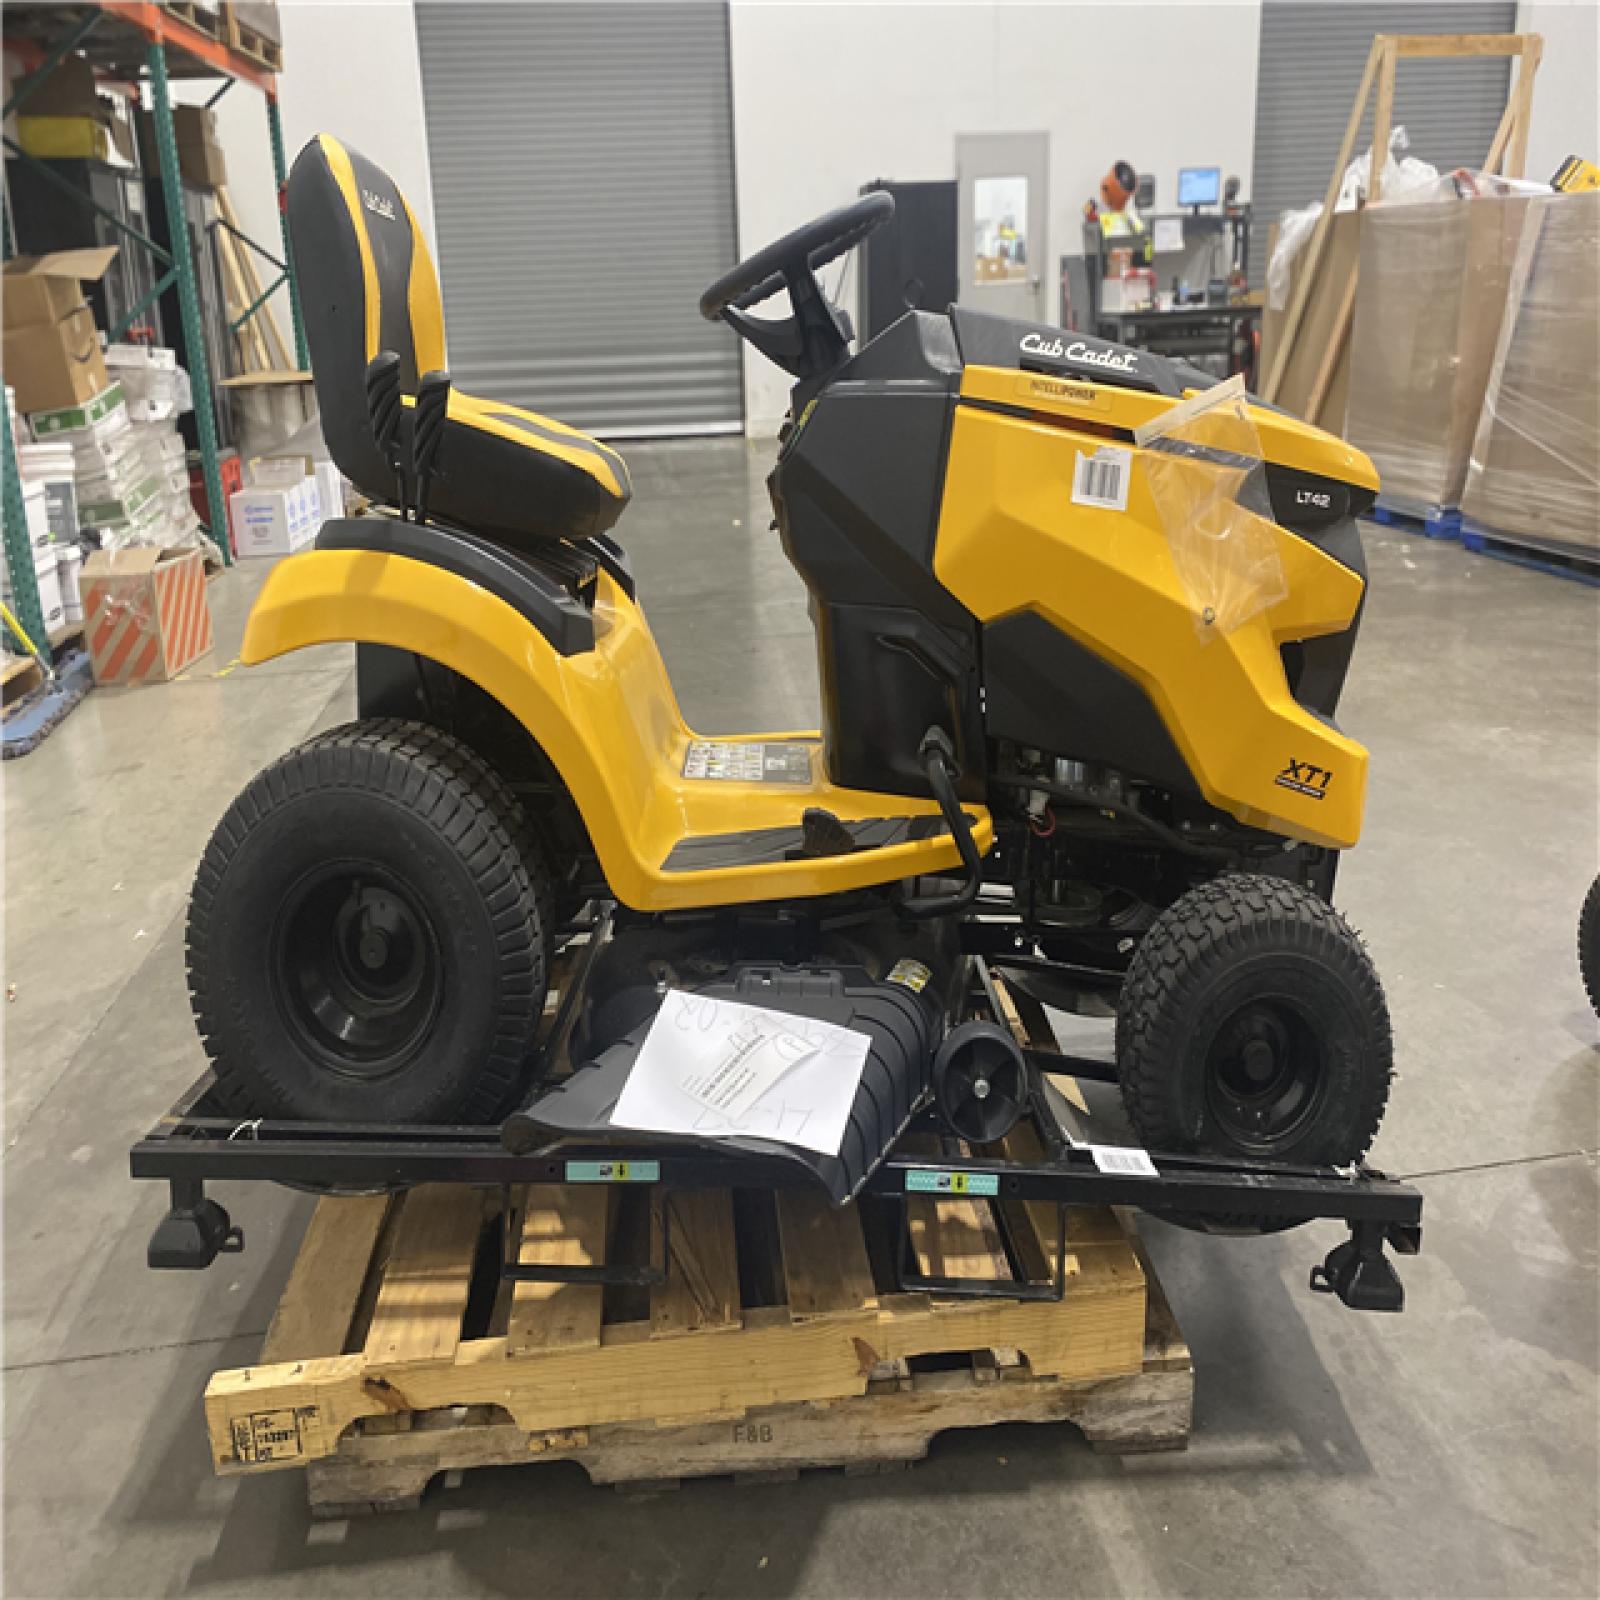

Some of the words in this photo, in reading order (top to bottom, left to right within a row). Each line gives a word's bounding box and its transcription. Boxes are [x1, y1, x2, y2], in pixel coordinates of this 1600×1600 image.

[1020, 333, 1063, 358] Cub
[1065, 342, 1138, 372] Cadet
[1296, 489, 1331, 508] LT42
[1280, 757, 1333, 788] XT1
[733, 1424, 773, 1443] F&B
